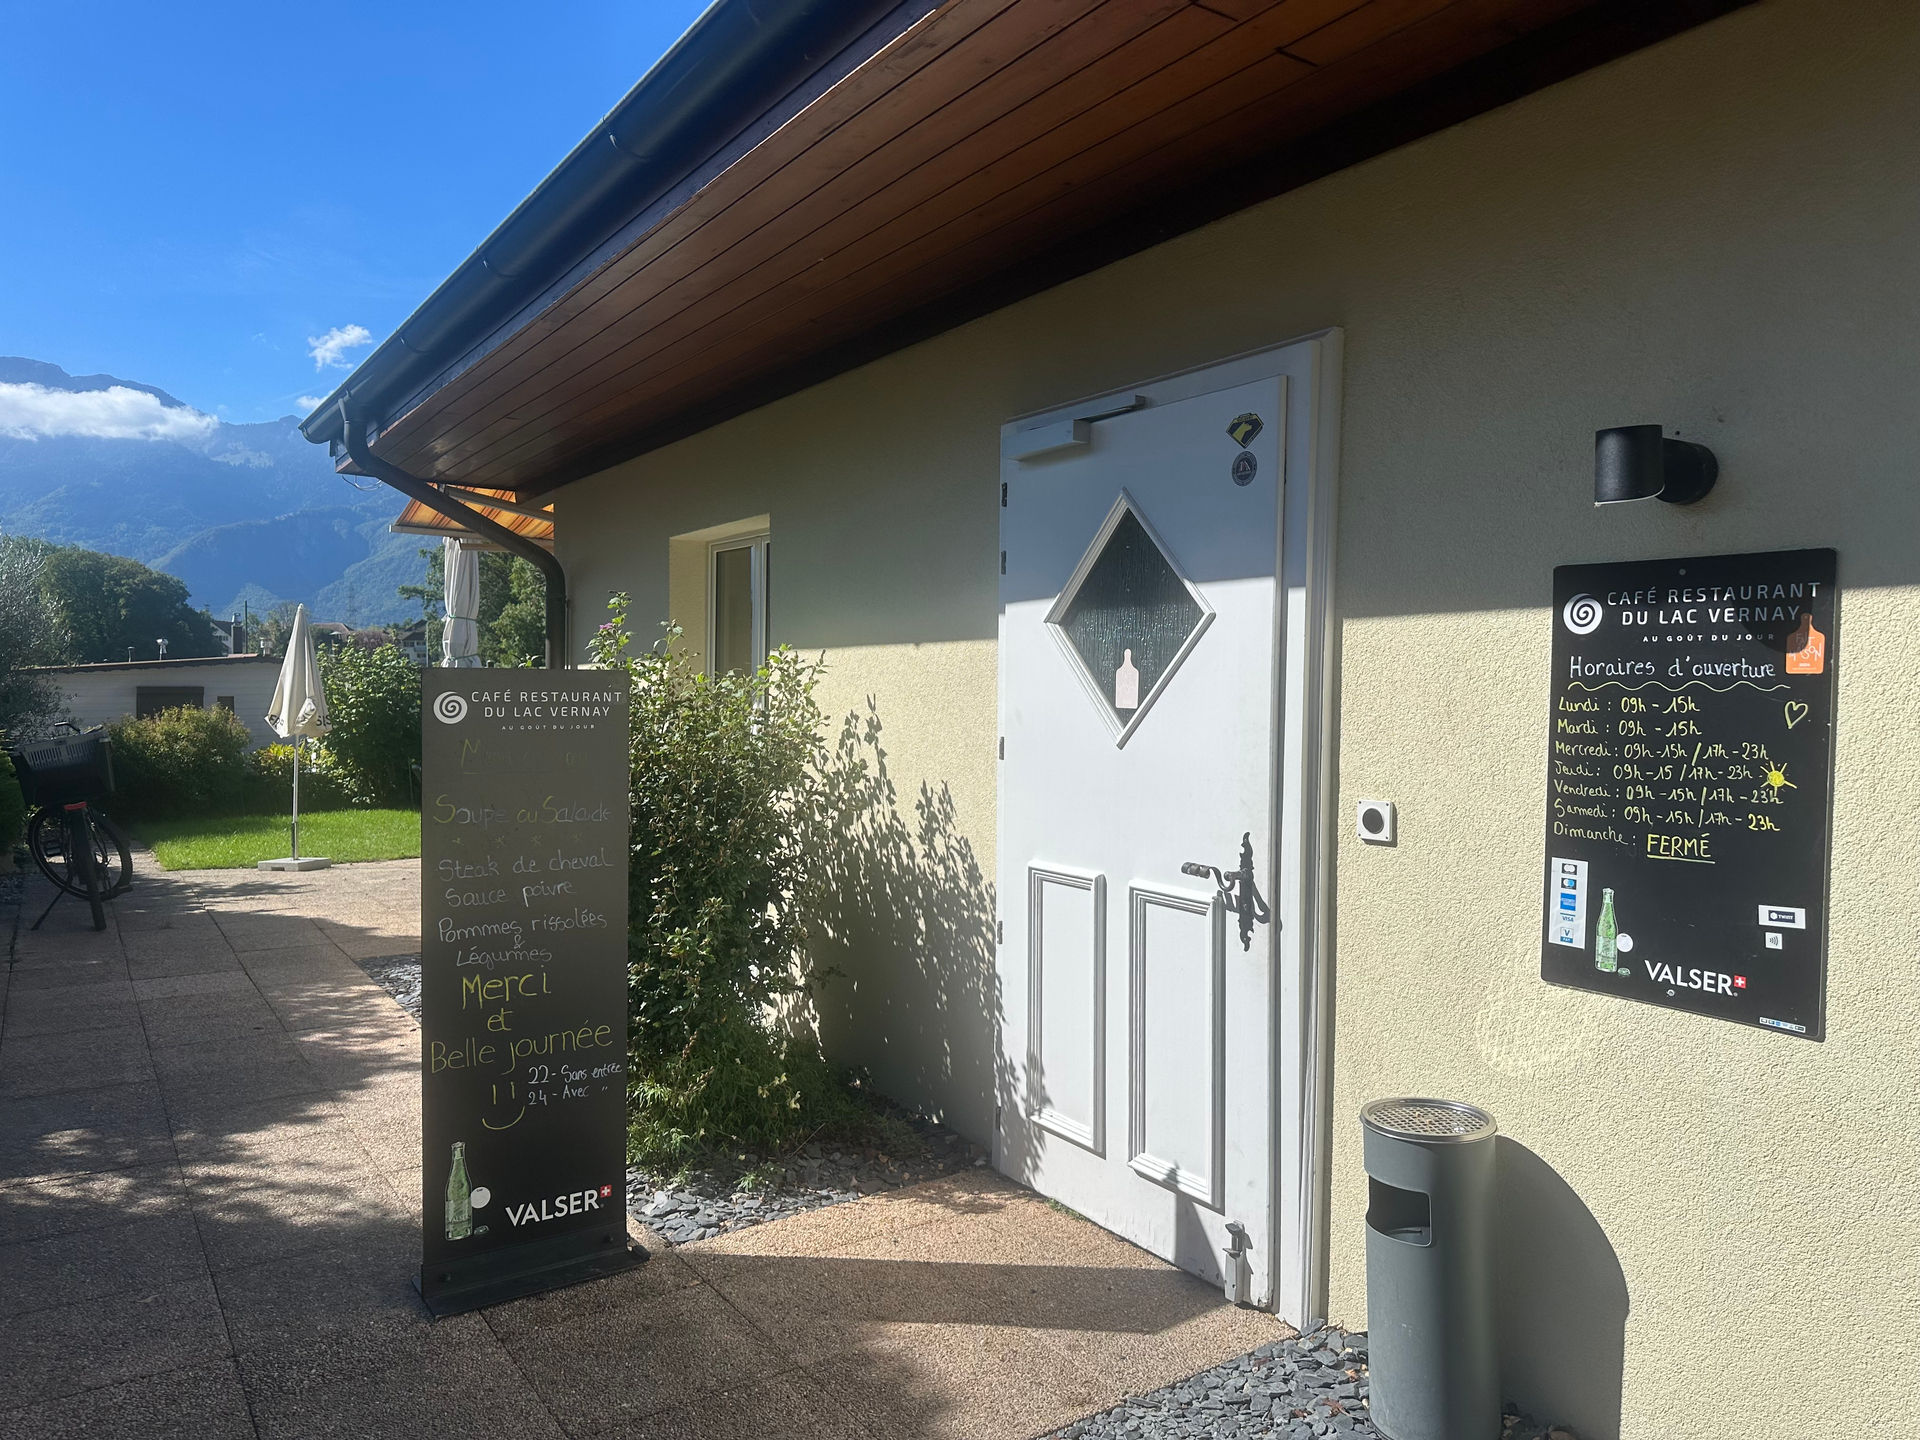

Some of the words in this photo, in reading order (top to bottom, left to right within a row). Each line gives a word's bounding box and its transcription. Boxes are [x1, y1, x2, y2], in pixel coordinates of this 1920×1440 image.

[1607, 586, 1657, 606] CAFÉ
[1668, 582, 1821, 603] RESTAURANT
[1622, 610, 1648, 626] DU
[1658, 609, 1698, 625] LAC
[1708, 605, 1800, 624] VERNAY
[1666, 633, 1703, 643] GOÛT
[1711, 634, 1729, 642] DU
[1736, 633, 1774, 642] JOUR
[1570, 655, 1655, 679] Horaires
[471, 689, 512, 702] CAFÉ
[520, 691, 622, 703] RESTAURANT
[1558, 696, 1600, 712] Lundi
[1621, 696, 1647, 713] 09h
[1662, 695, 1701, 714] 15h
[484, 707, 506, 718] DU
[514, 706, 543, 718] LAC
[550, 706, 610, 717] VERNAY
[1557, 718, 1599, 734] Mardi
[1618, 720, 1647, 737] 09h
[1665, 719, 1702, 737] 15h
[1555, 740, 1612, 757] Mercredi
[1624, 743, 1655, 760] 09h
[1742, 742, 1769, 760] 23h
[1554, 760, 1594, 776] Jeudi
[1613, 763, 1644, 781] 09h
[1727, 764, 1754, 780] 23h
[1553, 779, 1611, 798] Vendredi
[1626, 784, 1655, 800] 09h
[1667, 787, 1697, 802] 15h
[542, 796, 612, 824] Salade
[1553, 798, 1608, 818] Samedi
[1624, 806, 1653, 825] 09h
[1665, 810, 1694, 825] 15h
[1747, 813, 1781, 831] 23h
[1553, 821, 1629, 845] Dimanche
[1647, 832, 1712, 858] FERMÉ
[438, 855, 500, 881] Steak
[512, 855, 541, 873] de
[549, 847, 615, 871] cheval
[522, 880, 578, 907] poivre
[438, 917, 522, 943] Pommes
[531, 908, 608, 932] rissolées
[1561, 915, 1575, 923] VISA
[456, 946, 553, 970] Légumes
[462, 965, 551, 1010] Merci
[1644, 959, 1734, 996] VALSER
[487, 1007, 514, 1032] et
[431, 1037, 496, 1074] Belle
[562, 1084, 590, 1100] Avec
[505, 1189, 600, 1227] VALSER
